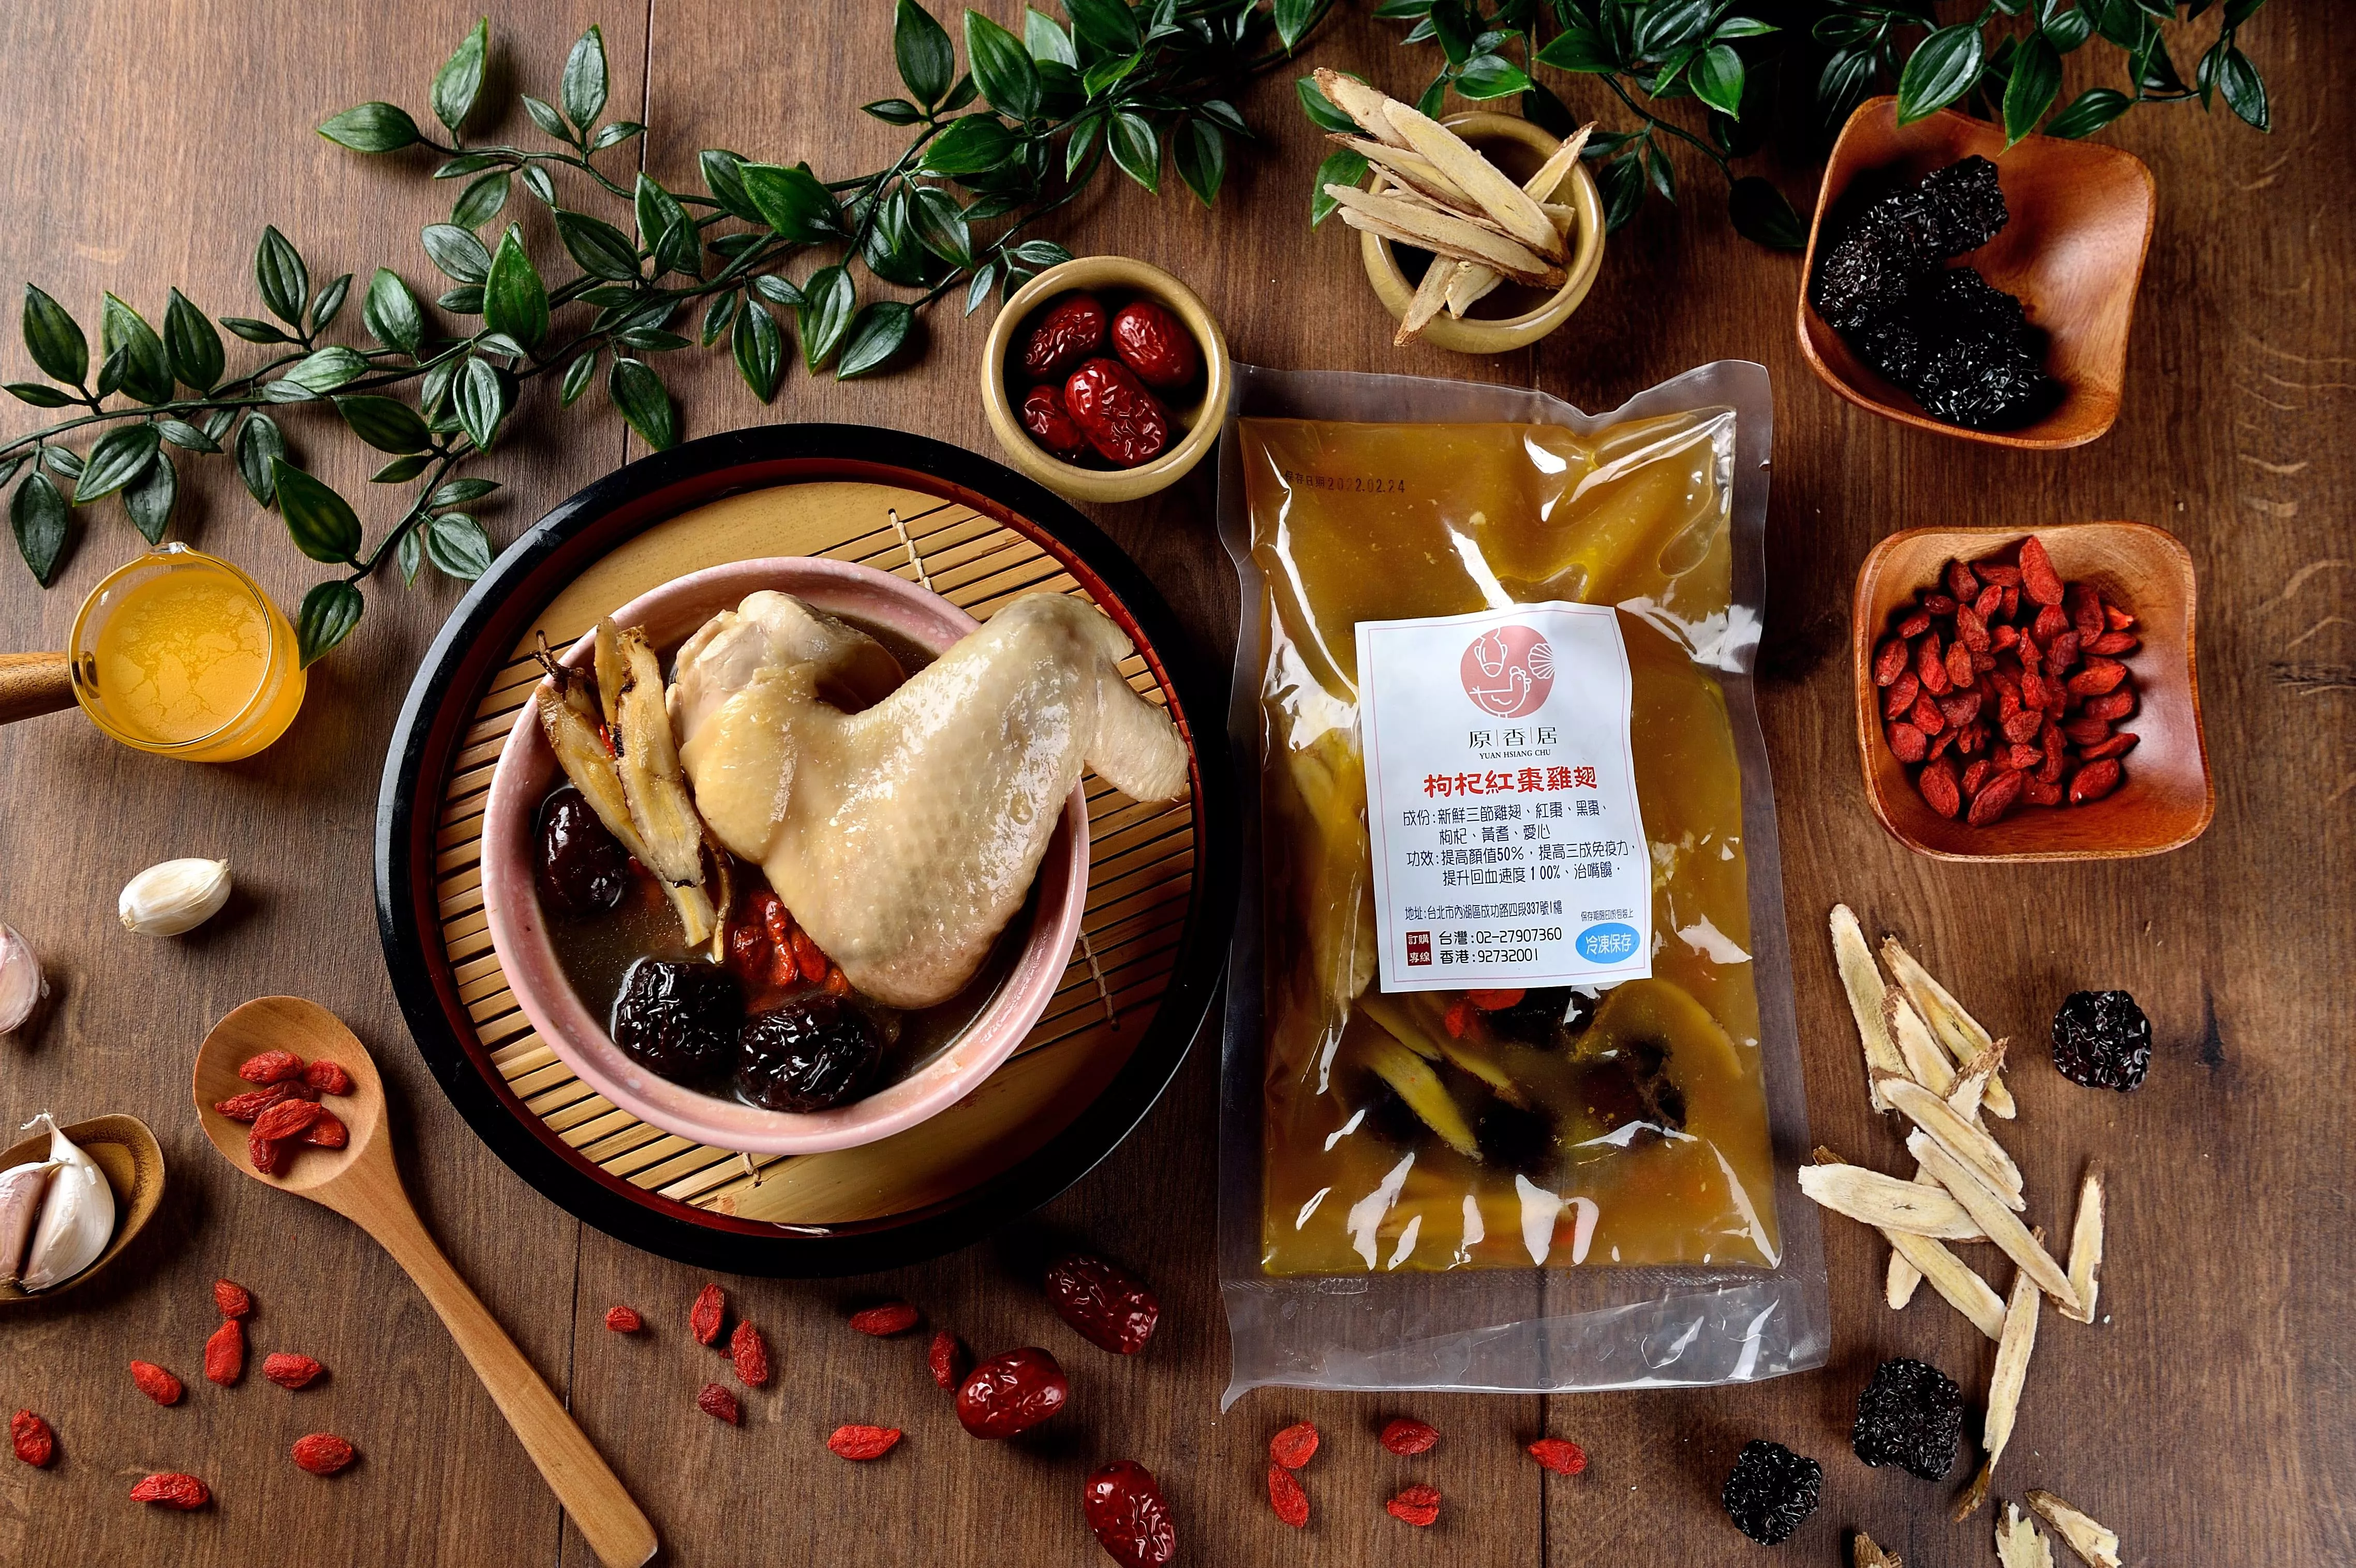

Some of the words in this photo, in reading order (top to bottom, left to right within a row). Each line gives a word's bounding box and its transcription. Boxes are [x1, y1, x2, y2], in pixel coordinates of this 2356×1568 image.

[1479, 751, 1502, 760] YUAN
[1503, 750, 1533, 759] HSIANG
[1424, 765, 1597, 798] 枸杞紅棗雞翅
[1581, 909, 1634, 922] 保存期限印於包裝上
[1407, 934, 1429, 946] 訂購
[1586, 933, 1632, 955] 冷凍保存
[1409, 951, 1430, 963] 專線
